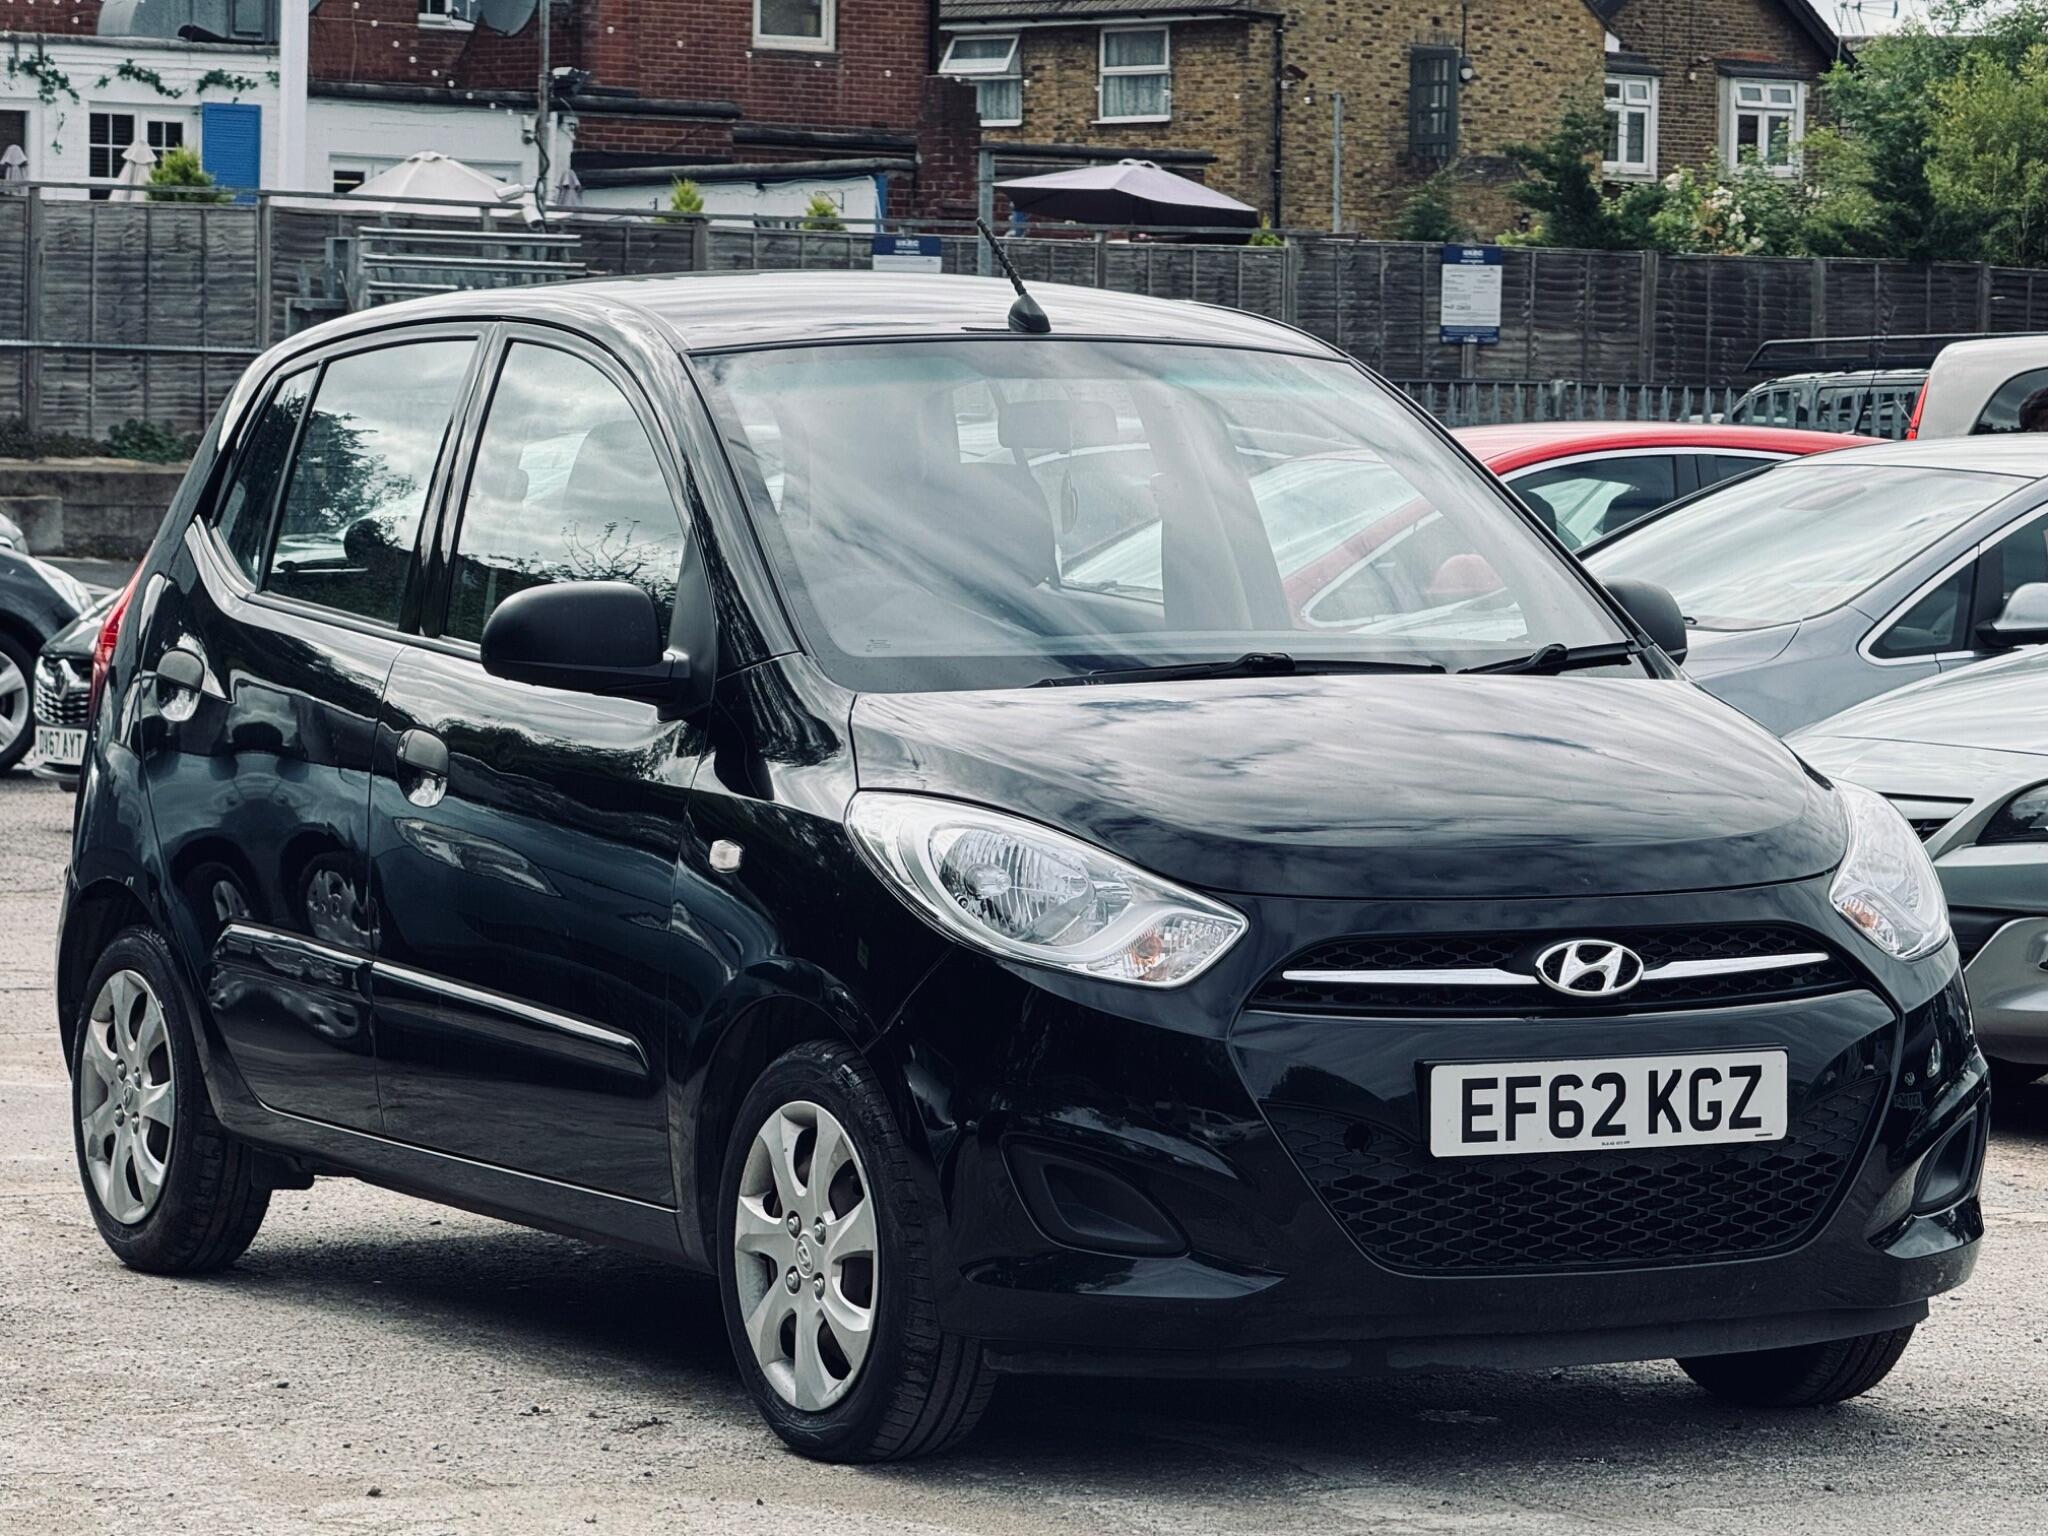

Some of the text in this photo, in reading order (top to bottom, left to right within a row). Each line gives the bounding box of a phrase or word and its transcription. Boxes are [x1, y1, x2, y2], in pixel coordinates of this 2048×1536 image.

[63, 732, 82, 758] AYT
[1462, 1065, 1762, 1143] EF62 KGZ
